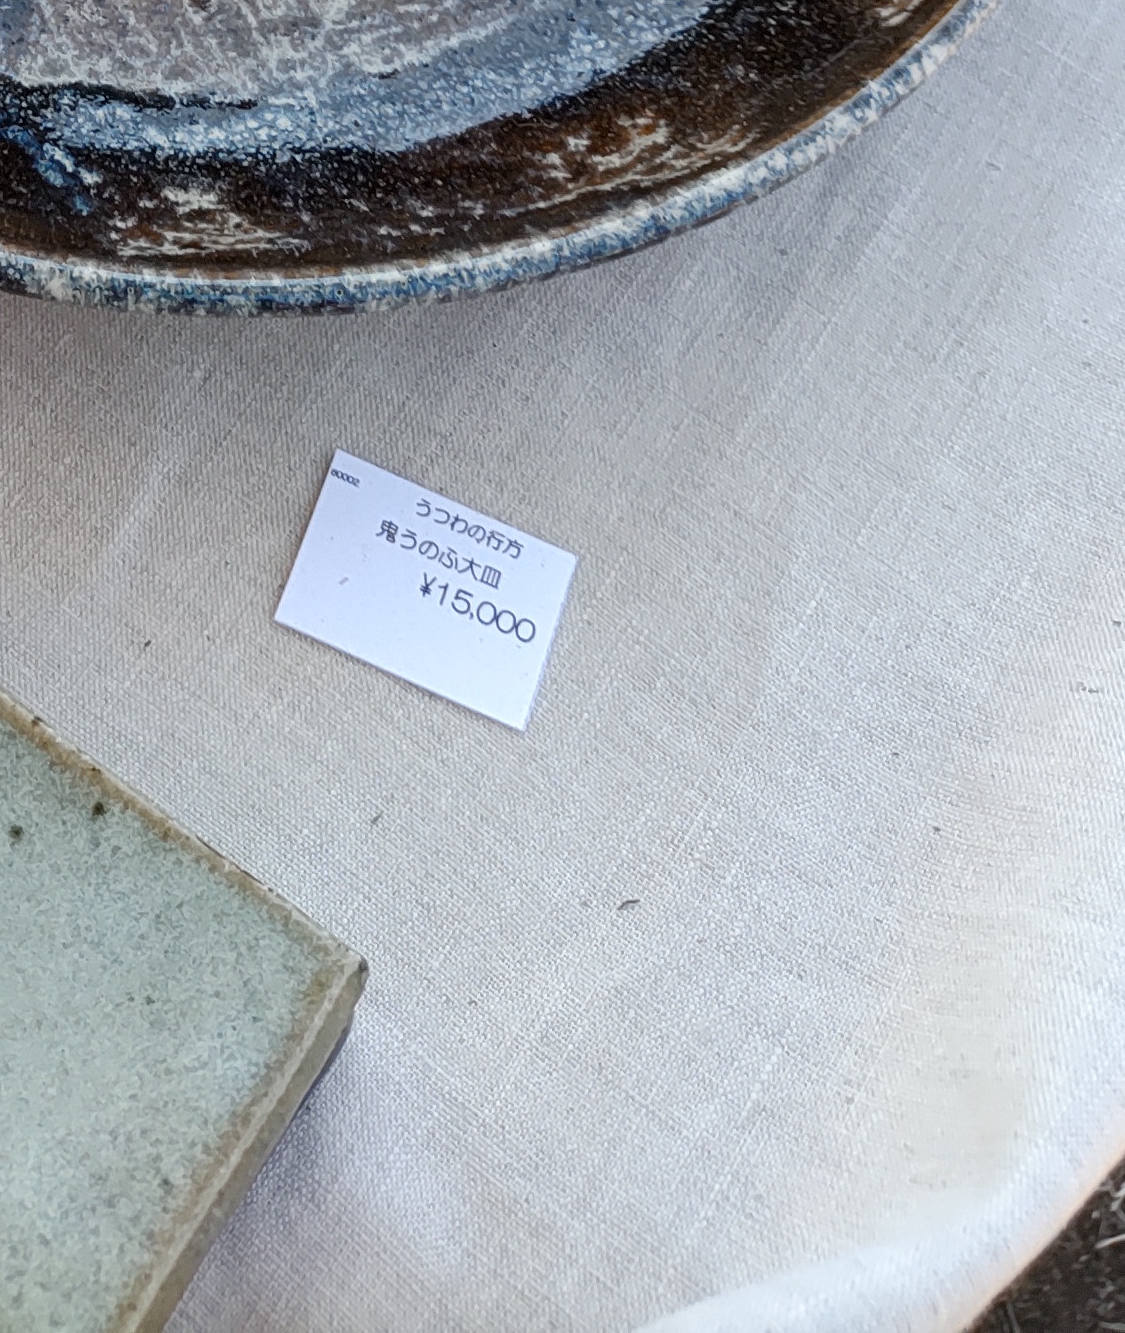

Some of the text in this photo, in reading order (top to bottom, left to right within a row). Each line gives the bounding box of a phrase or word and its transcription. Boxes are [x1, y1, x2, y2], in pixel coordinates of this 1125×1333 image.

[375, 519, 503, 590] 鬼うのふ大皿
[415, 498, 525, 559] うつわの行方
[419, 572, 536, 643] ¥15,000
